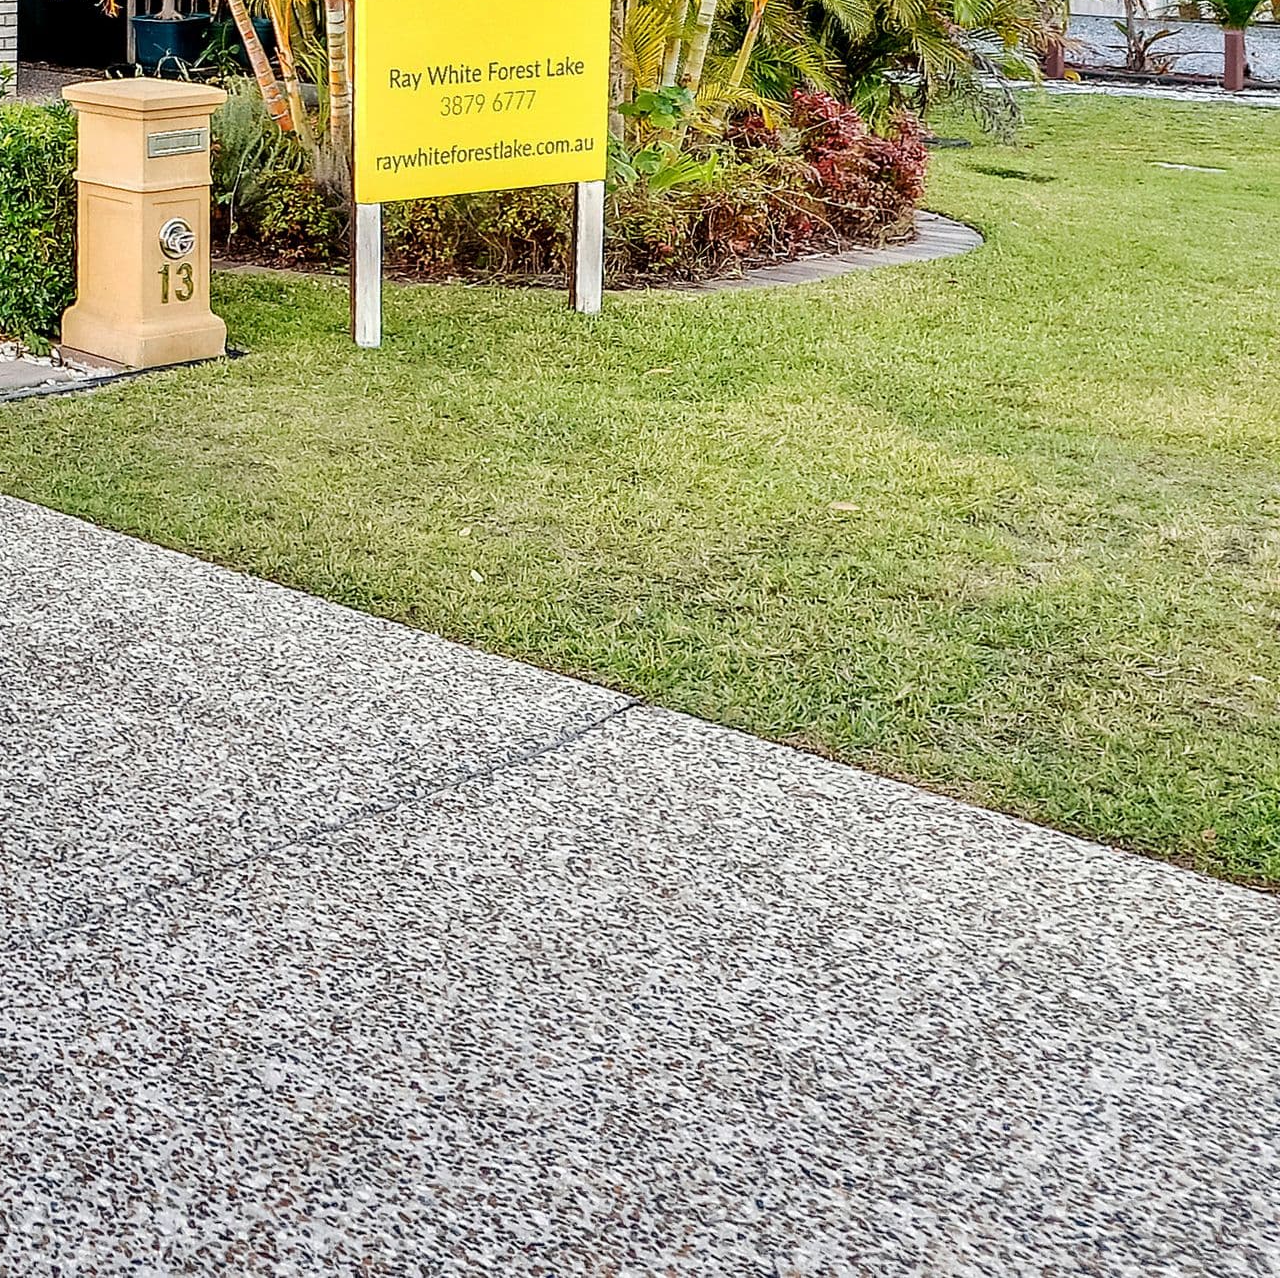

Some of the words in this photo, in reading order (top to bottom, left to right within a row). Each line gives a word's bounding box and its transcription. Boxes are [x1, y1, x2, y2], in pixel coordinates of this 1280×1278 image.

[389, 69, 422, 91] Ray
[427, 64, 482, 85] White
[488, 60, 541, 82] Forest
[546, 56, 585, 77] Lake
[440, 93, 486, 117] 3879
[492, 90, 537, 112] 6777
[376, 137, 594, 173] raywhiteforestlake.com.au
[157, 262, 195, 304] 13
